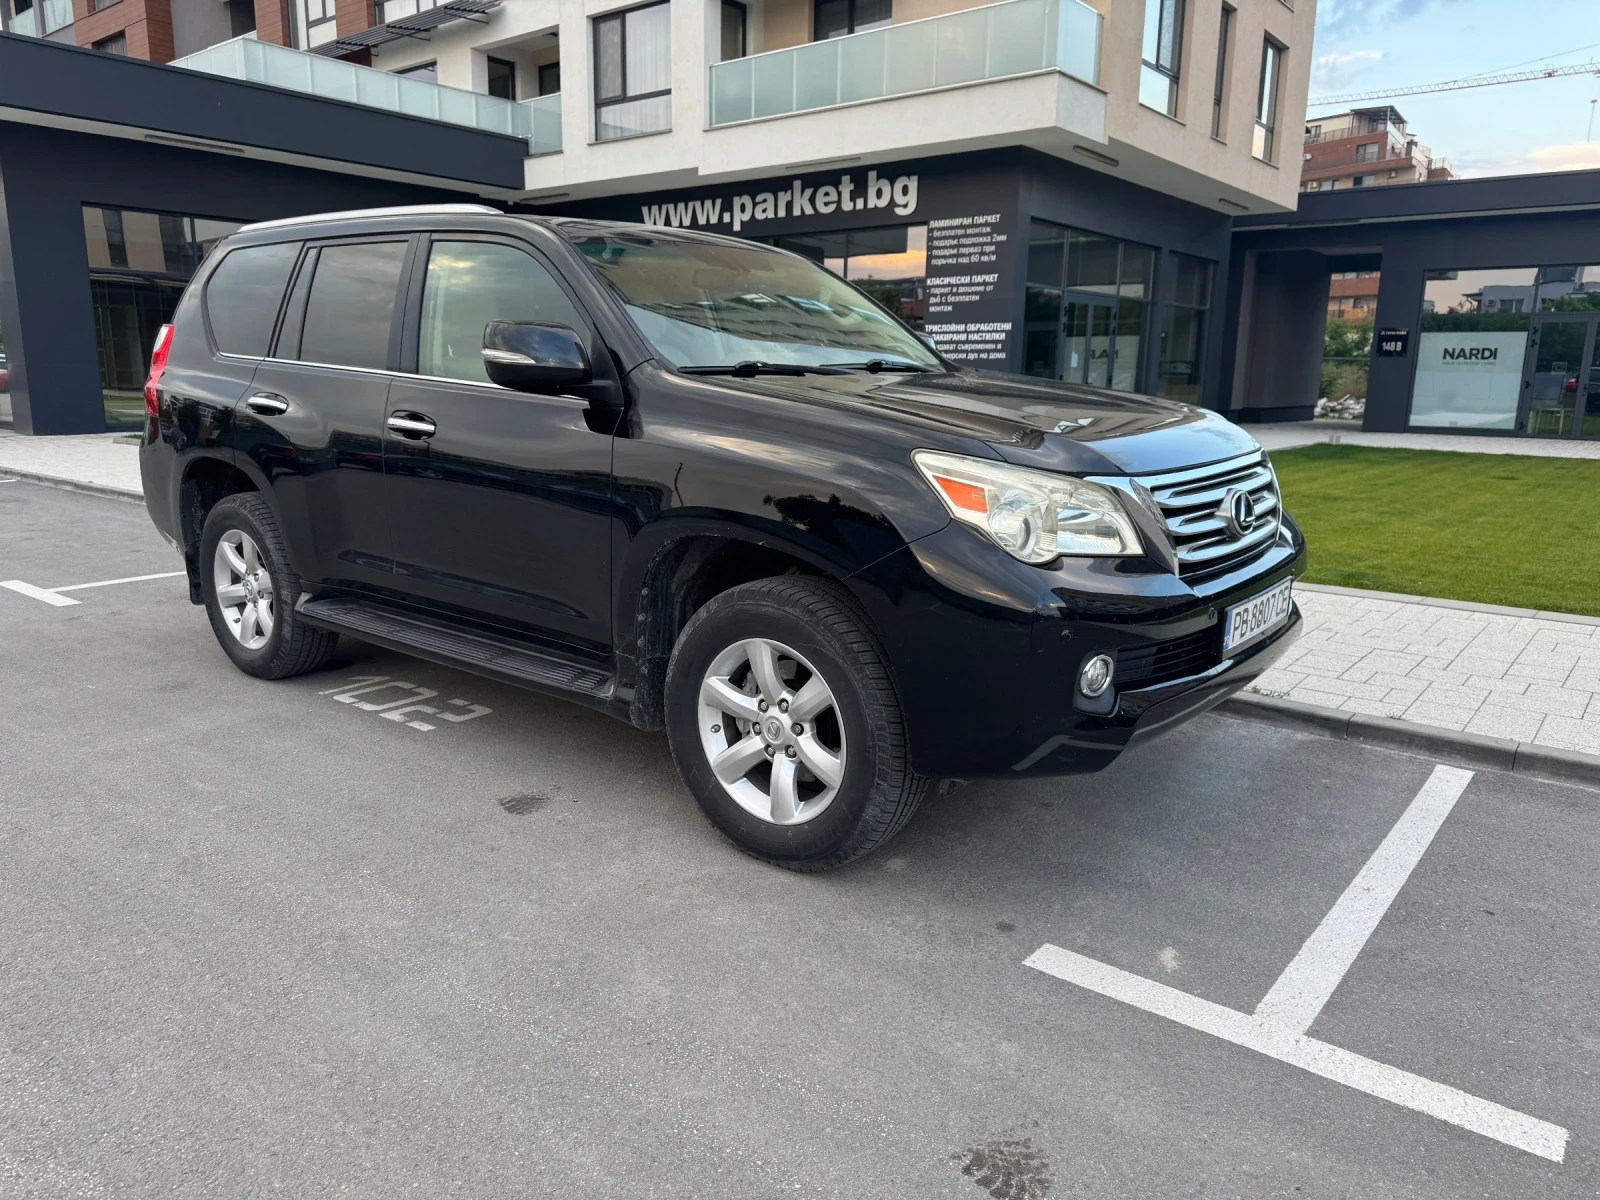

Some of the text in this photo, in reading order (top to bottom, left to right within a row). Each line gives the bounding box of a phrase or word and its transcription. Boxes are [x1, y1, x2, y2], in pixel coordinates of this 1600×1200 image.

[641, 170, 919, 231] www.parket.bg
[929, 214, 1000, 228] ЛАМИНИРАН ПАРКЕТ
[933, 226, 991, 237] безплатен монтаж
[960, 236, 991, 245] подложка
[992, 234, 1007, 242] 2мм
[983, 245, 995, 254] при
[970, 254, 979, 262] 60
[927, 274, 998, 286] КЛАСИЧЕСКИ ПАРКЕТ
[930, 286, 951, 295] паркет
[958, 285, 985, 293] дюшеме
[947, 294, 980, 302] безплатен
[925, 322, 1012, 332] ТРИСЛОЙНИ ОБРАБОТЕНИ
[968, 332, 1006, 340] НАСТИЛКИ
[967, 352, 978, 360] дух
[1442, 347, 1498, 360] NARDI
